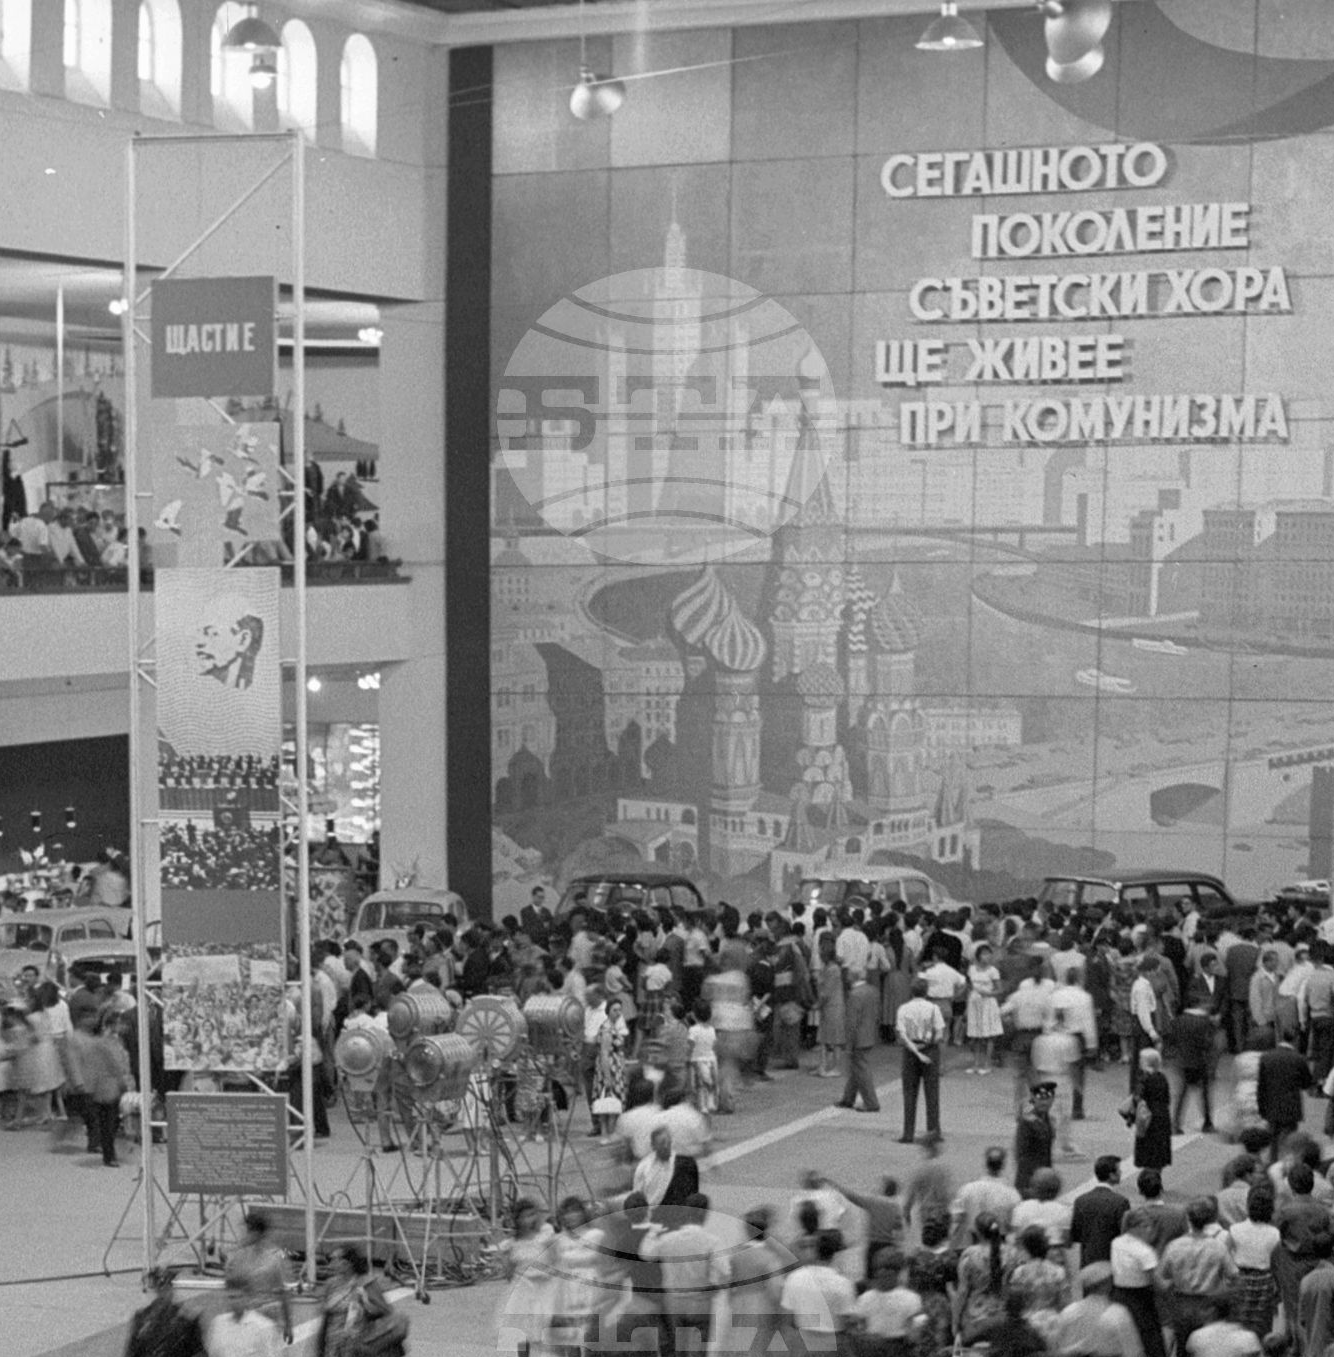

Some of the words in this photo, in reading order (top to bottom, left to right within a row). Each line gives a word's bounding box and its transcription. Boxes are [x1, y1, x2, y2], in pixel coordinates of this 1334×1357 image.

[880, 141, 1168, 198] СЕГАШНОТО
[971, 202, 1250, 258] ПОКОЛЕНИЕ
[909, 271, 1149, 321] СЪВЕТСКИ
[1165, 265, 1292, 314] ХОРА
[165, 321, 256, 355] ЩАСТИЕ
[875, 338, 945, 386] ЩЕ
[966, 334, 1125, 383] ЖИВЕЕ
[900, 400, 981, 445] ПРИ
[1003, 391, 1290, 443] КОМУНИЗМА
